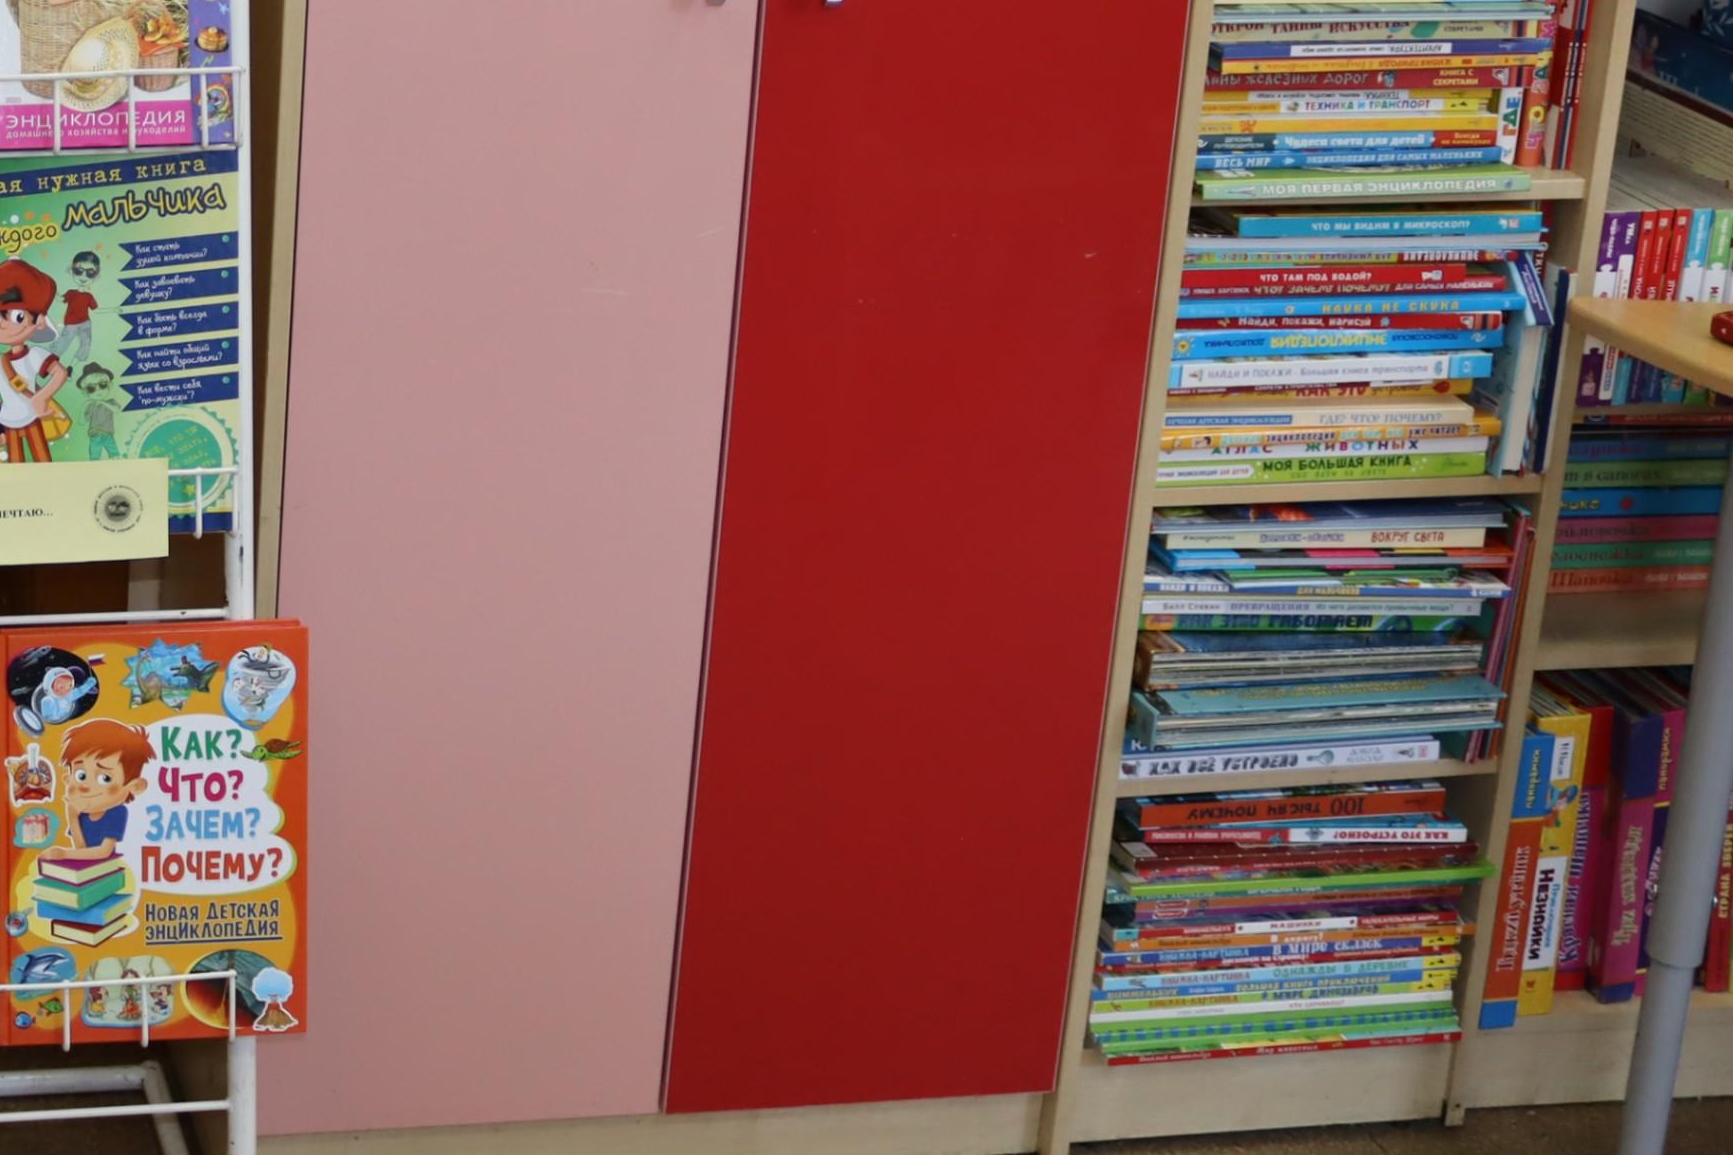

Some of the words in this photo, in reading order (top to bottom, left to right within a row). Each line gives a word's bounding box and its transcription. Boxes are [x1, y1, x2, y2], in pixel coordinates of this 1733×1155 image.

[1305, 100, 1354, 111] ТЕХНИКА
[1357, 100, 1366, 109] И
[1369, 99, 1430, 110] ТРАНСПОРТ
[38, 168, 122, 192] нужная
[137, 158, 206, 178] книга
[1262, 183, 1298, 195] МОЯ
[1301, 181, 1363, 194] ПЕРВАЯ
[1367, 179, 1496, 193] ЭНЦИКЛОПЕДИЯ
[1260, 273, 1279, 282] ЧТО
[1283, 272, 1304, 282] ТАМ
[1308, 272, 1329, 283] ПОД
[1332, 271, 1372, 281] ВОДОЙ?
[1263, 460, 1293, 472] МОЯ
[1299, 458, 1365, 470] БОЛЬШАЯ
[1370, 456, 1412, 467] КНИГА
[1371, 532, 1410, 543] ВОКРУГ
[1414, 531, 1444, 542] СВЕТА
[1187, 805, 1257, 820] ПОЧЕМУ
[1331, 797, 1364, 815] 100
[146, 920, 278, 941] ЭНЦИКЛОПЕДИЯ
